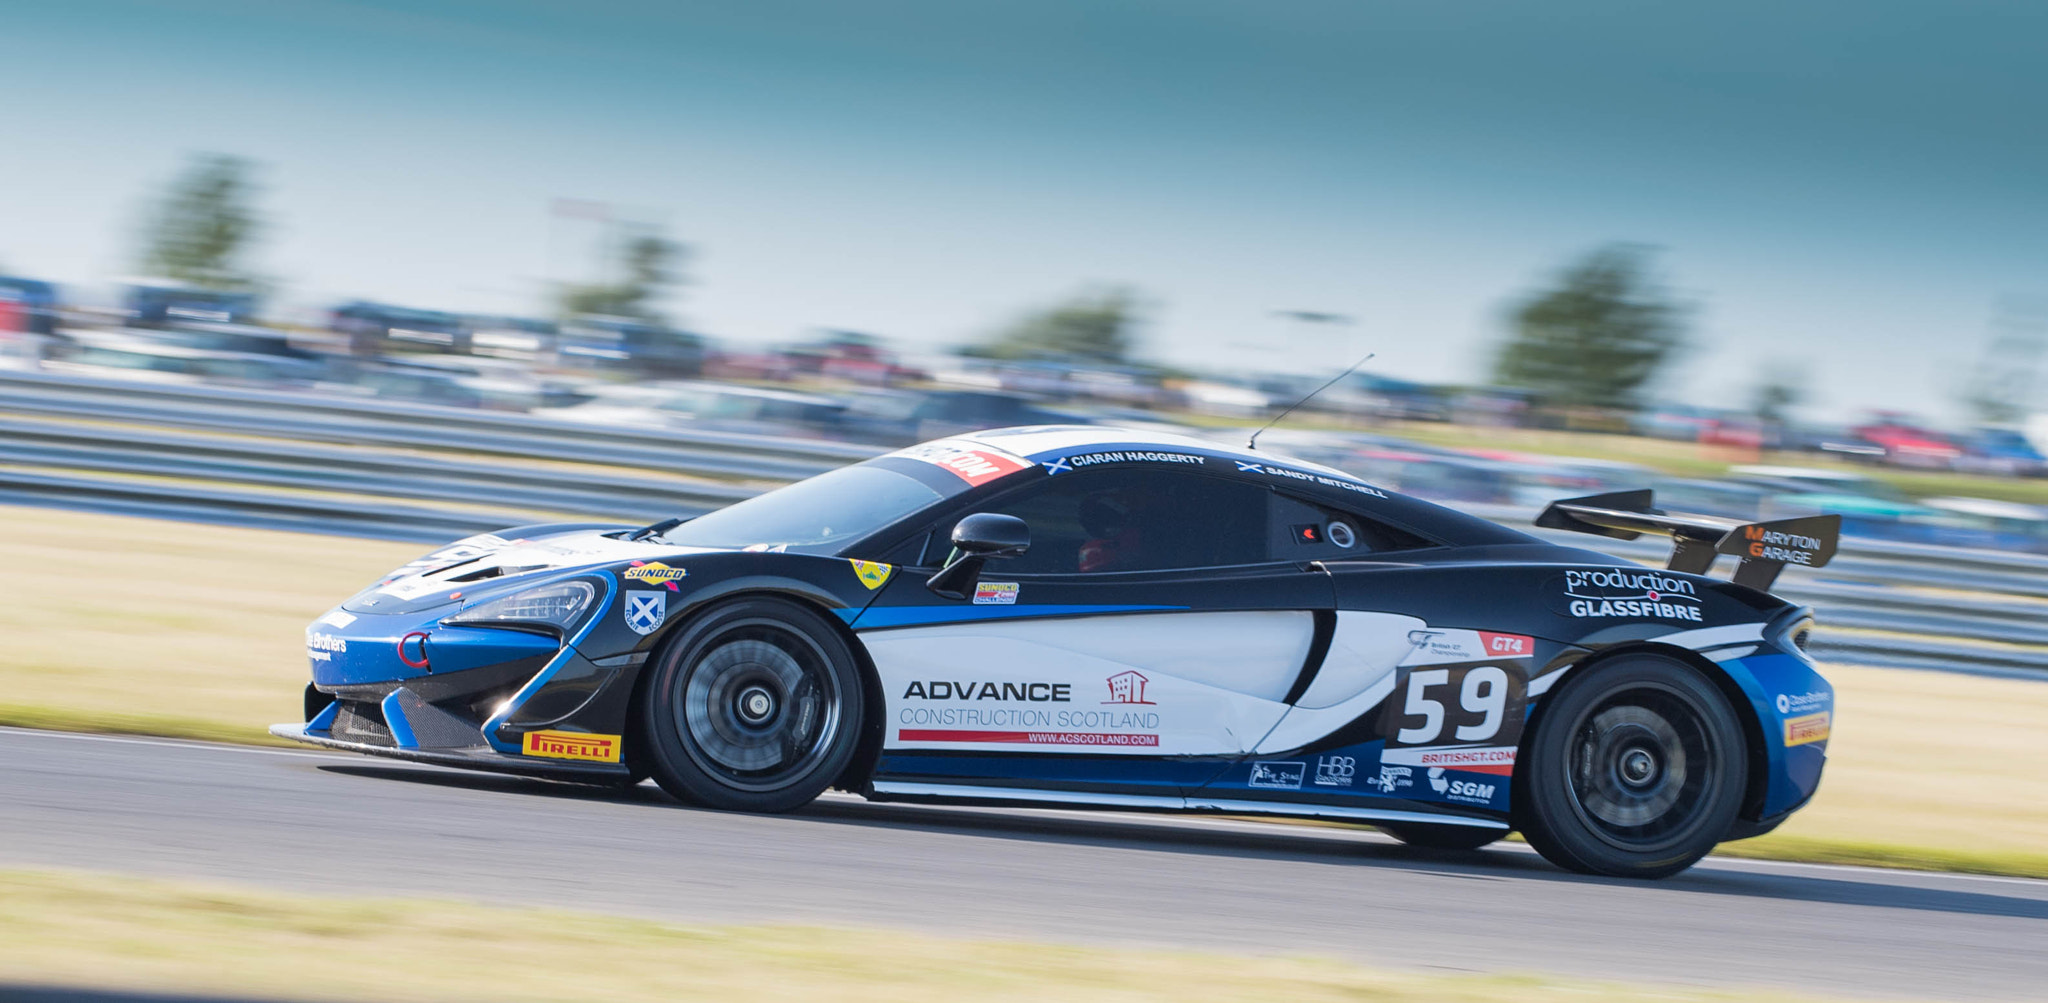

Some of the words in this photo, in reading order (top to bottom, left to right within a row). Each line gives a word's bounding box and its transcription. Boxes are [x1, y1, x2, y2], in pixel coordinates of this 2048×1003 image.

[1072, 452, 1124, 467] CIARAN
[1125, 451, 1204, 465] HAGGERTY
[1266, 467, 1315, 482] SANDY
[1316, 476, 1389, 500] MITCHELL
[1745, 525, 1821, 550] MARYTON
[1749, 542, 1812, 565] GARAGE
[628, 568, 685, 579] SUNOCO
[1565, 568, 1695, 595] production
[625, 609, 639, 631] ECURIE
[648, 610, 664, 631] ECOSSE
[1570, 600, 1703, 621] GLASSFIBRE
[313, 632, 347, 653] Brothers
[1491, 637, 1523, 652] GT4
[903, 681, 1072, 702] ADVANCE
[1397, 666, 1508, 744] 59
[900, 708, 1050, 727] CONSTRUCTION
[1057, 711, 1160, 729] SCOTLAND
[530, 733, 612, 758] PIRELLI
[1028, 733, 1156, 746] WWW.ACSCOTLAND.COM
[1317, 756, 1355, 777] HBB
[1421, 753, 1516, 763] BRITISHGT.COM
[1449, 780, 1496, 799] SGM
